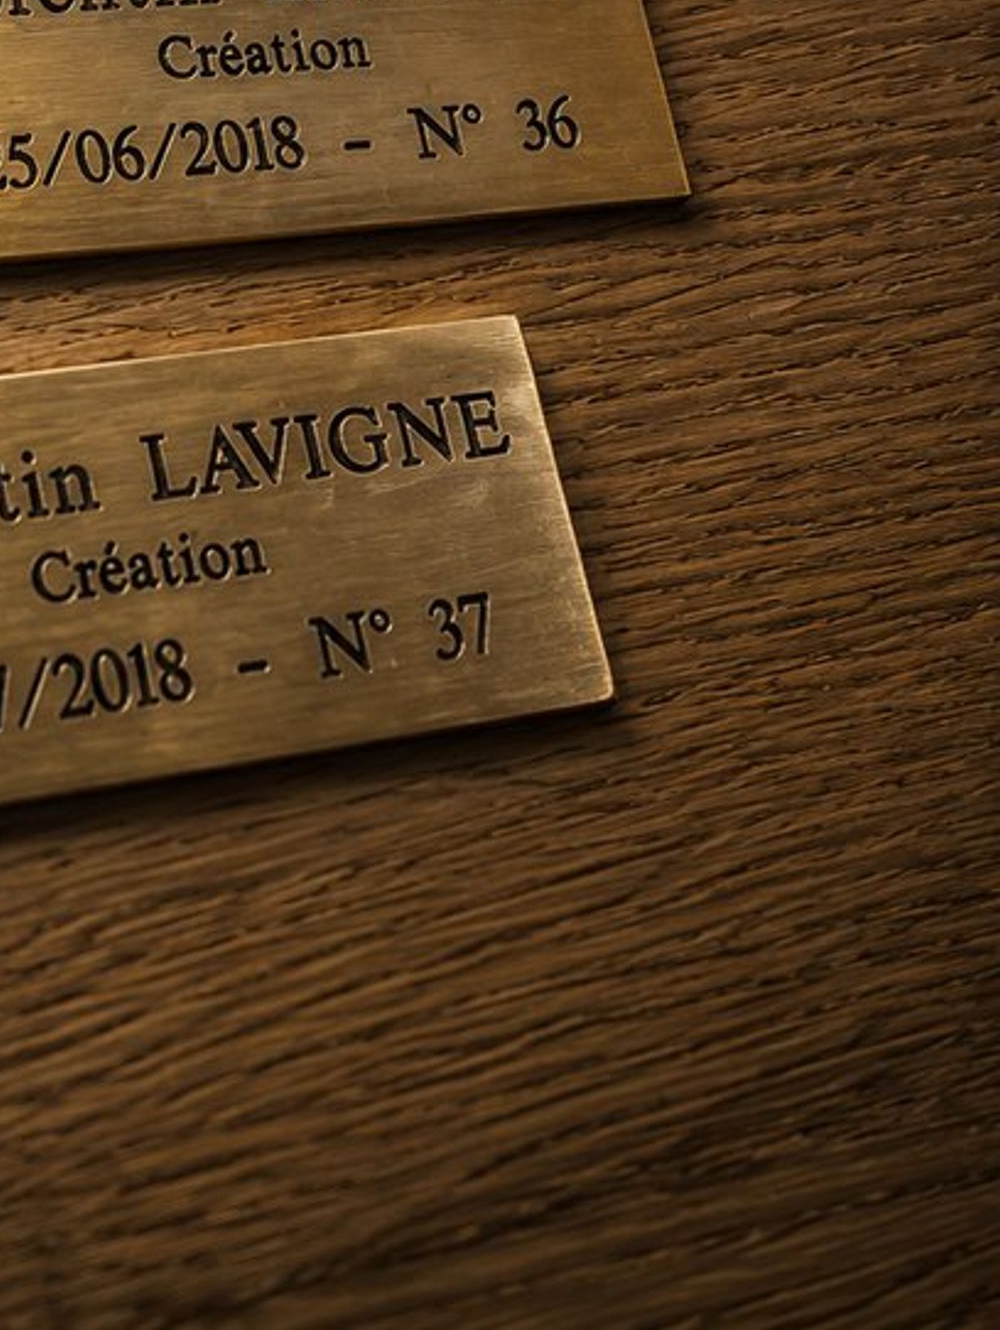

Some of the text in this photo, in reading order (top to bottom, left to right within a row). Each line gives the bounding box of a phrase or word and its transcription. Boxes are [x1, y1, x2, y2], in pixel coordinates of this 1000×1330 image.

[157, 31, 371, 81] Création
[520, 94, 581, 152] 36
[142, 389, 514, 504] LAVIGNE
[31, 528, 270, 606] Création
[426, 592, 494, 658] 37
